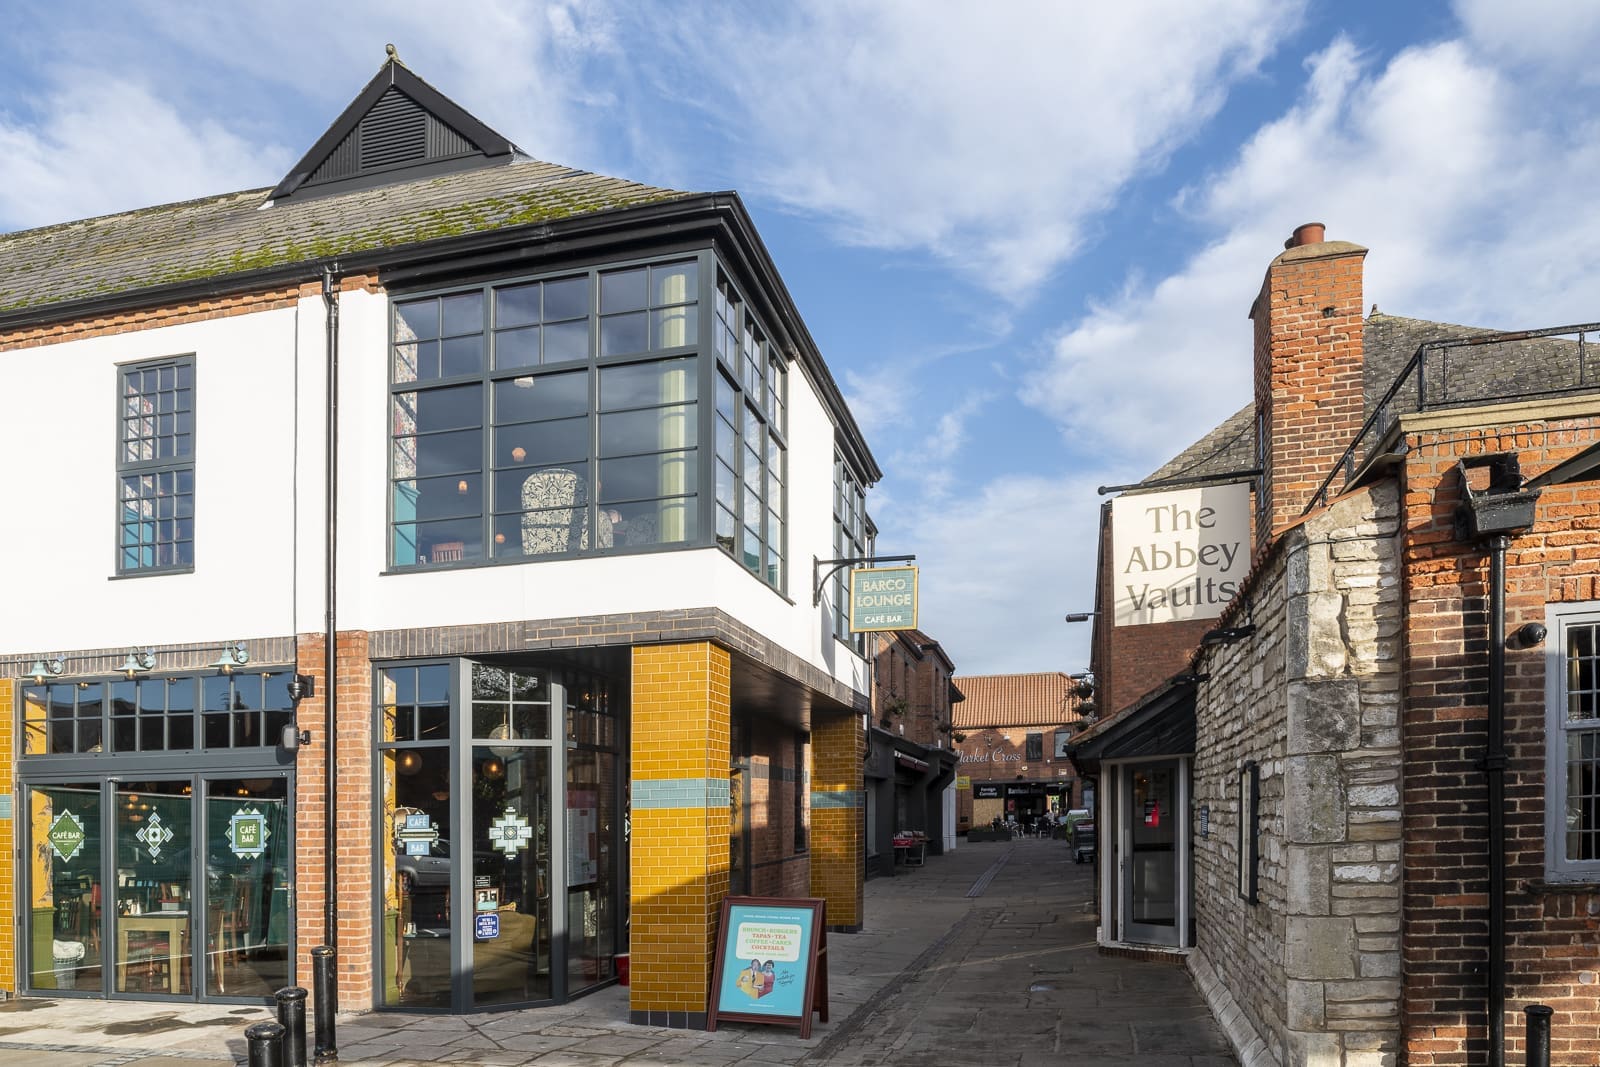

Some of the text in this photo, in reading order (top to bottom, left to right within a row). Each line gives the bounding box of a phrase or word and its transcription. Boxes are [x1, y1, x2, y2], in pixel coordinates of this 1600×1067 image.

[1145, 504, 1217, 533] The
[1124, 541, 1241, 574] Abbey
[862, 578, 906, 592] BARCO
[856, 593, 911, 608] LOUNGE
[1126, 577, 1237, 611] Vaults
[864, 614, 902, 624] CAFÉ BAR
[992, 745, 1022, 762] Cross
[52, 830, 68, 839] CAFÉ
[240, 823, 257, 834] CAFÉ
[241, 834, 255, 843] BAR
[410, 844, 425, 853] BAR
